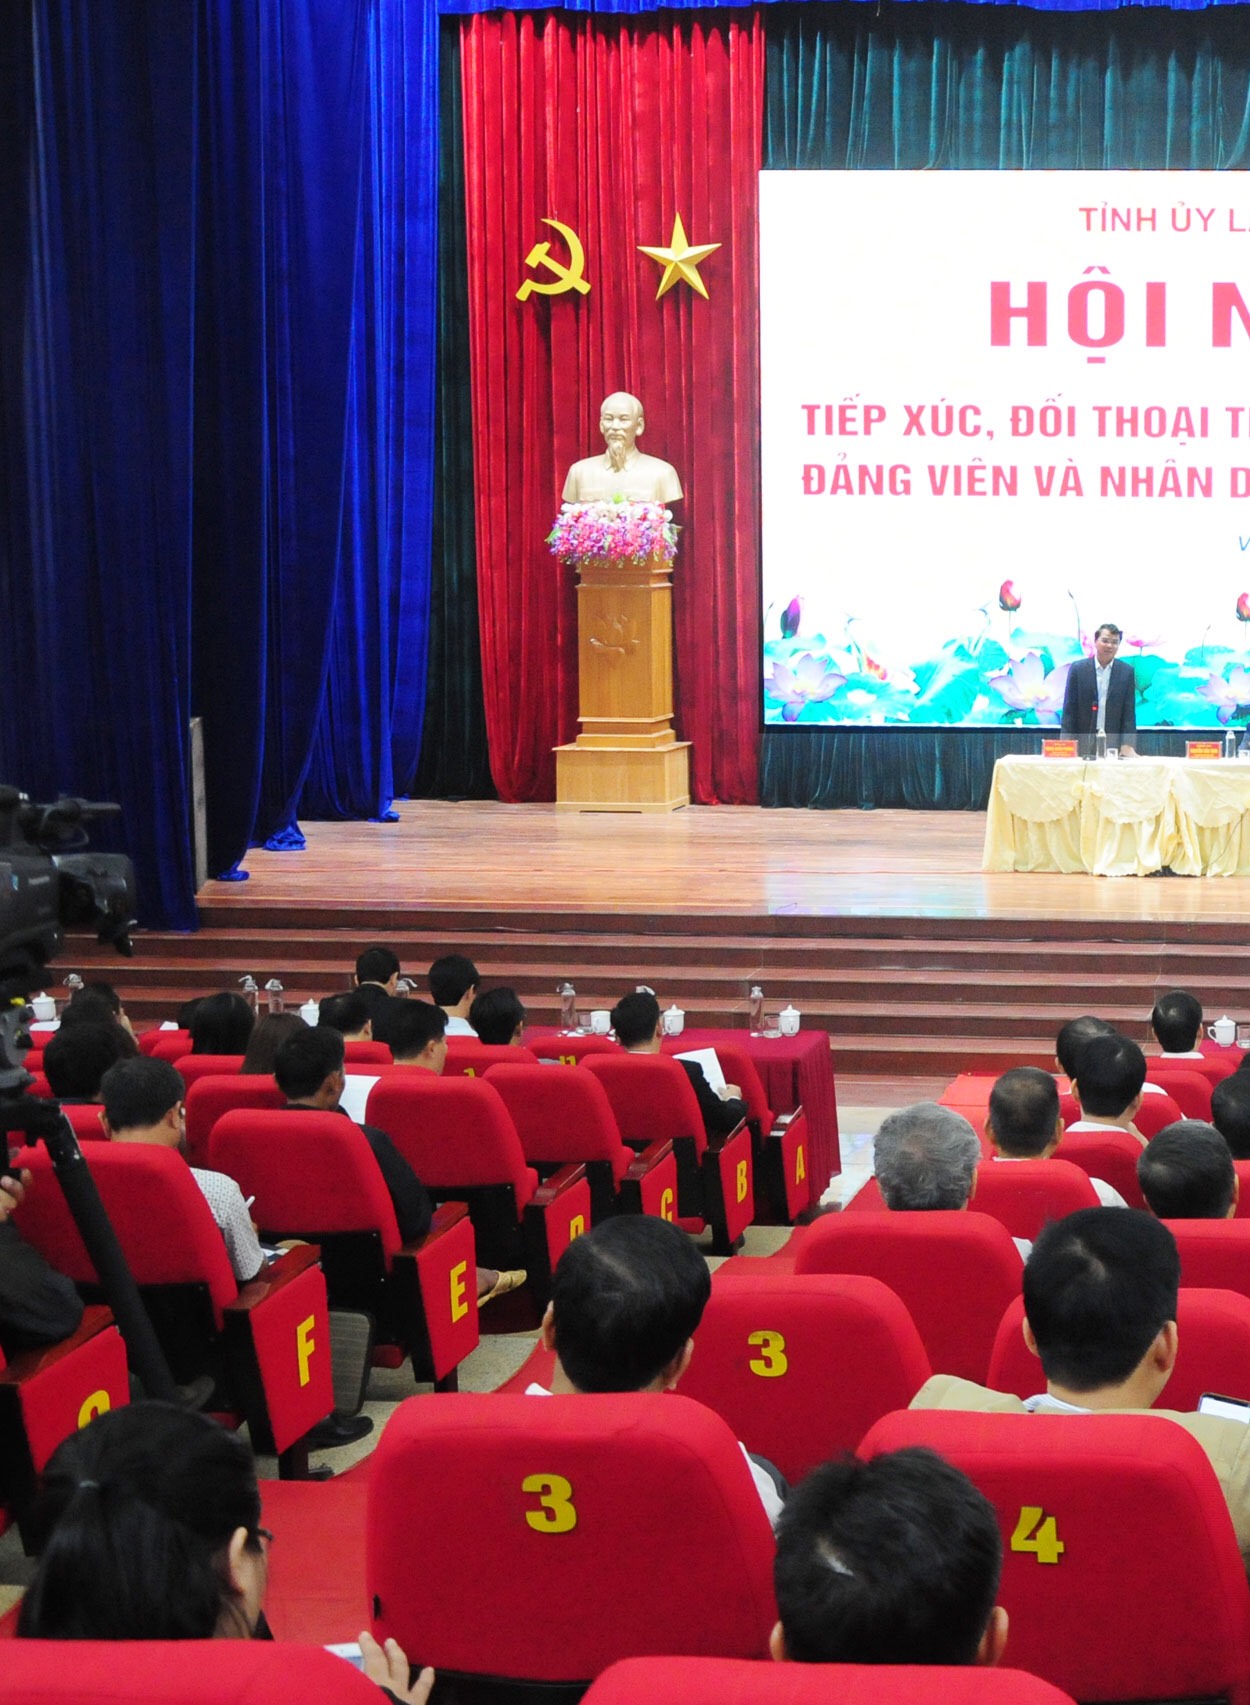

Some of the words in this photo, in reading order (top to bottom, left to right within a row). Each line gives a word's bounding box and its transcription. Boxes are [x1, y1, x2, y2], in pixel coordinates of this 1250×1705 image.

[1079, 201, 1157, 232] TỈNH
[1171, 201, 1216, 232] ỦY
[990, 265, 1167, 364] HỘI
[801, 393, 887, 436] TIẾP
[903, 398, 995, 440] XÚC,
[1009, 393, 1076, 437] ĐỐI
[1092, 405, 1209, 446] THOẠI
[801, 451, 912, 496] ĐẢNG
[927, 457, 1018, 497] VIÊN
[1033, 458, 1084, 497] VÀ
[1100, 459, 1213, 498] NHÂN
[736, 1160, 748, 1203] B
[795, 1144, 806, 1185] A
[450, 1261, 469, 1323] E
[296, 1314, 315, 1387] F
[747, 1330, 788, 1377] 3
[522, 1473, 577, 1533] 3
[1010, 1506, 1065, 1564] 4
